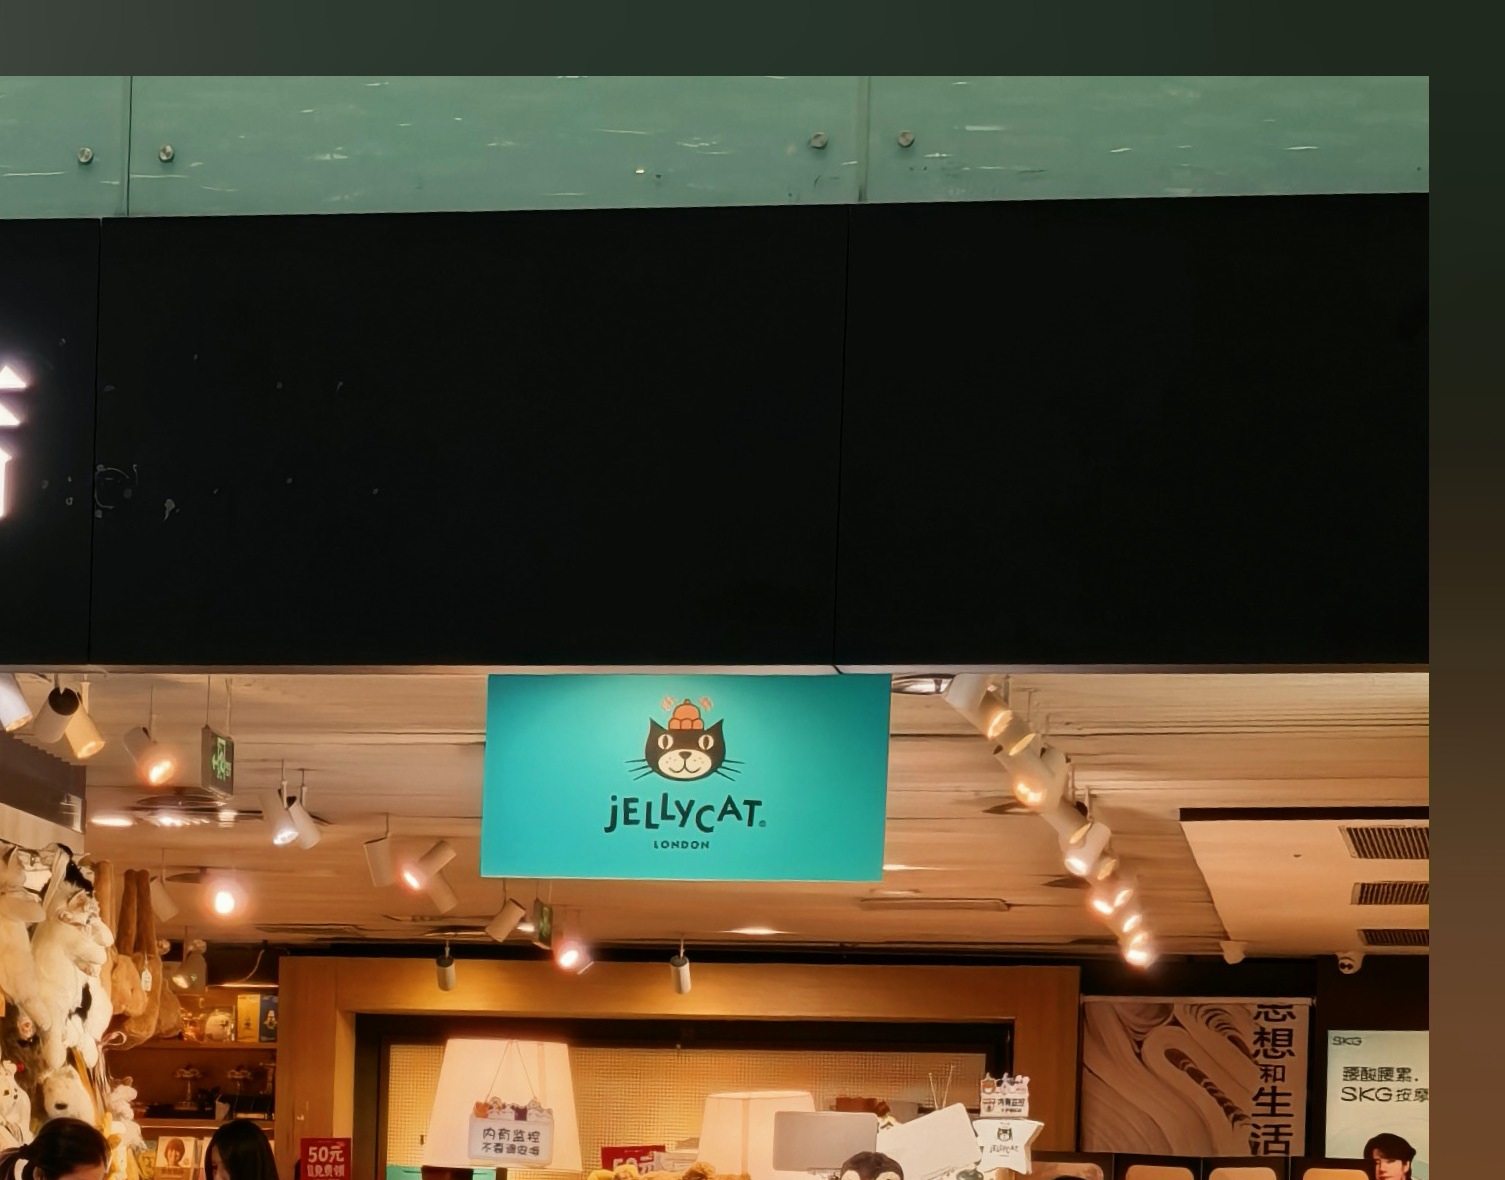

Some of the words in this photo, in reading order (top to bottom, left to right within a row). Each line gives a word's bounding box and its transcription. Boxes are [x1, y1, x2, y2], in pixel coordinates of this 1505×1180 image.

[653, 840, 710, 850] LONDON
[1331, 1036, 1363, 1046] SKG
[307, 1145, 345, 1163] 50元
